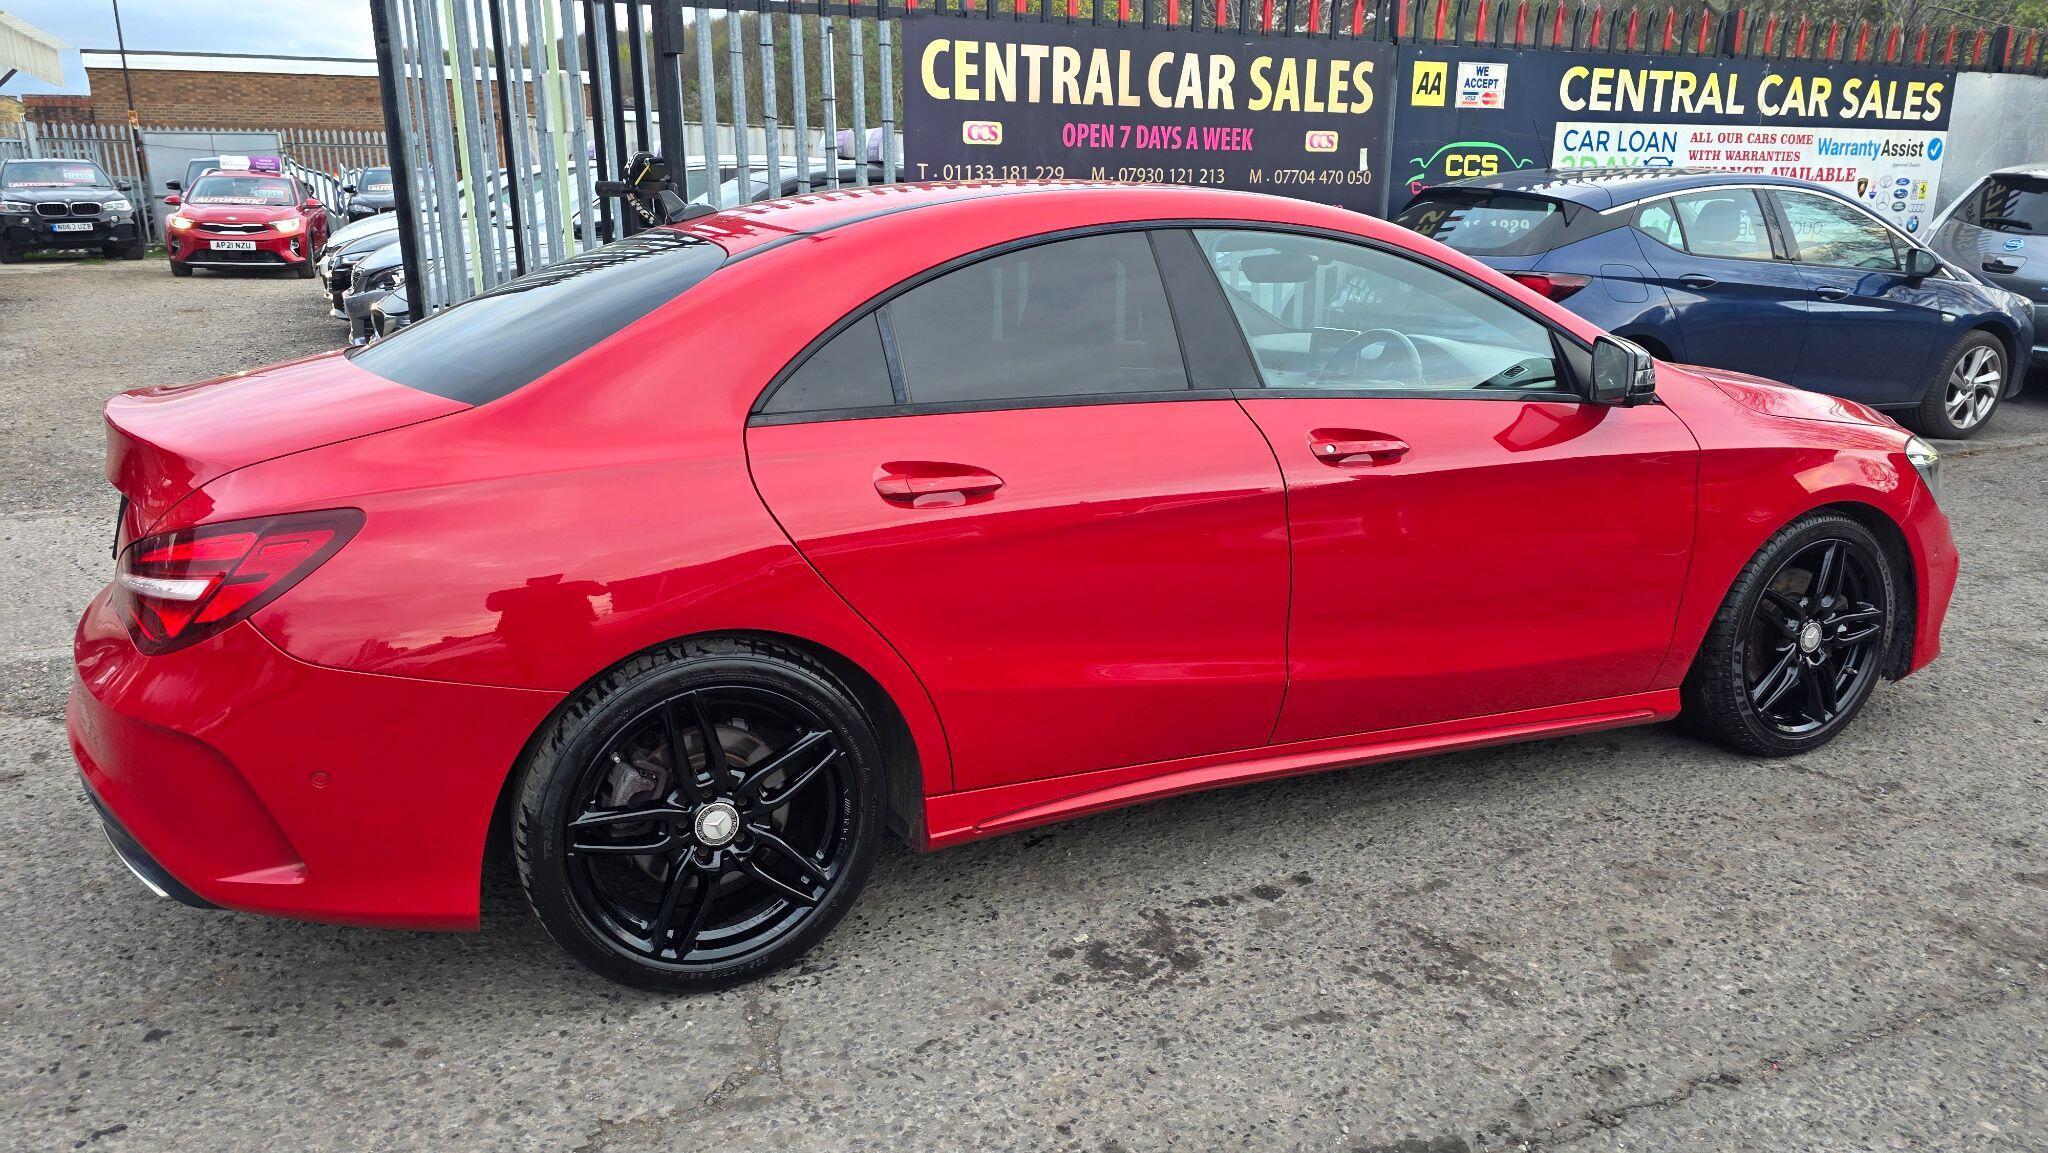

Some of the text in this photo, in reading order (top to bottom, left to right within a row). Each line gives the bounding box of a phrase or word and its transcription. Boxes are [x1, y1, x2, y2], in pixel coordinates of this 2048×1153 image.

[921, 38, 1375, 114] CENTRAL CAR SALES
[1476, 66, 1490, 77] WE
[1416, 71, 1442, 95] AA
[1464, 78, 1499, 89] ACCEPT
[1559, 66, 1945, 122] CENTRAL CAR SALES
[967, 124, 999, 142] CCS
[1062, 122, 1254, 151] OPEN 7 DAYS A WEEK
[1309, 133, 1335, 149] CCS
[1563, 129, 1678, 153] CAR LOAN
[1690, 132, 1814, 145] ALL OUR CARS COME
[1688, 149, 1801, 162] WITH WARRANTIES
[943, 164, 994, 181] 01133
[1001, 165, 1028, 181] 181
[1035, 165, 1065, 181] 229
[1446, 154, 1499, 177] CCS
[1771, 166, 1857, 182] AVAILABLE
[1118, 167, 1164, 183] 07930
[1169, 168, 1193, 183] 121
[1199, 168, 1225, 184] 213
[1274, 169, 1316, 185] 07704
[1318, 169, 1344, 185] 470
[1347, 170, 1372, 185] 050
[215, 241, 251, 249] AP21 NZU
